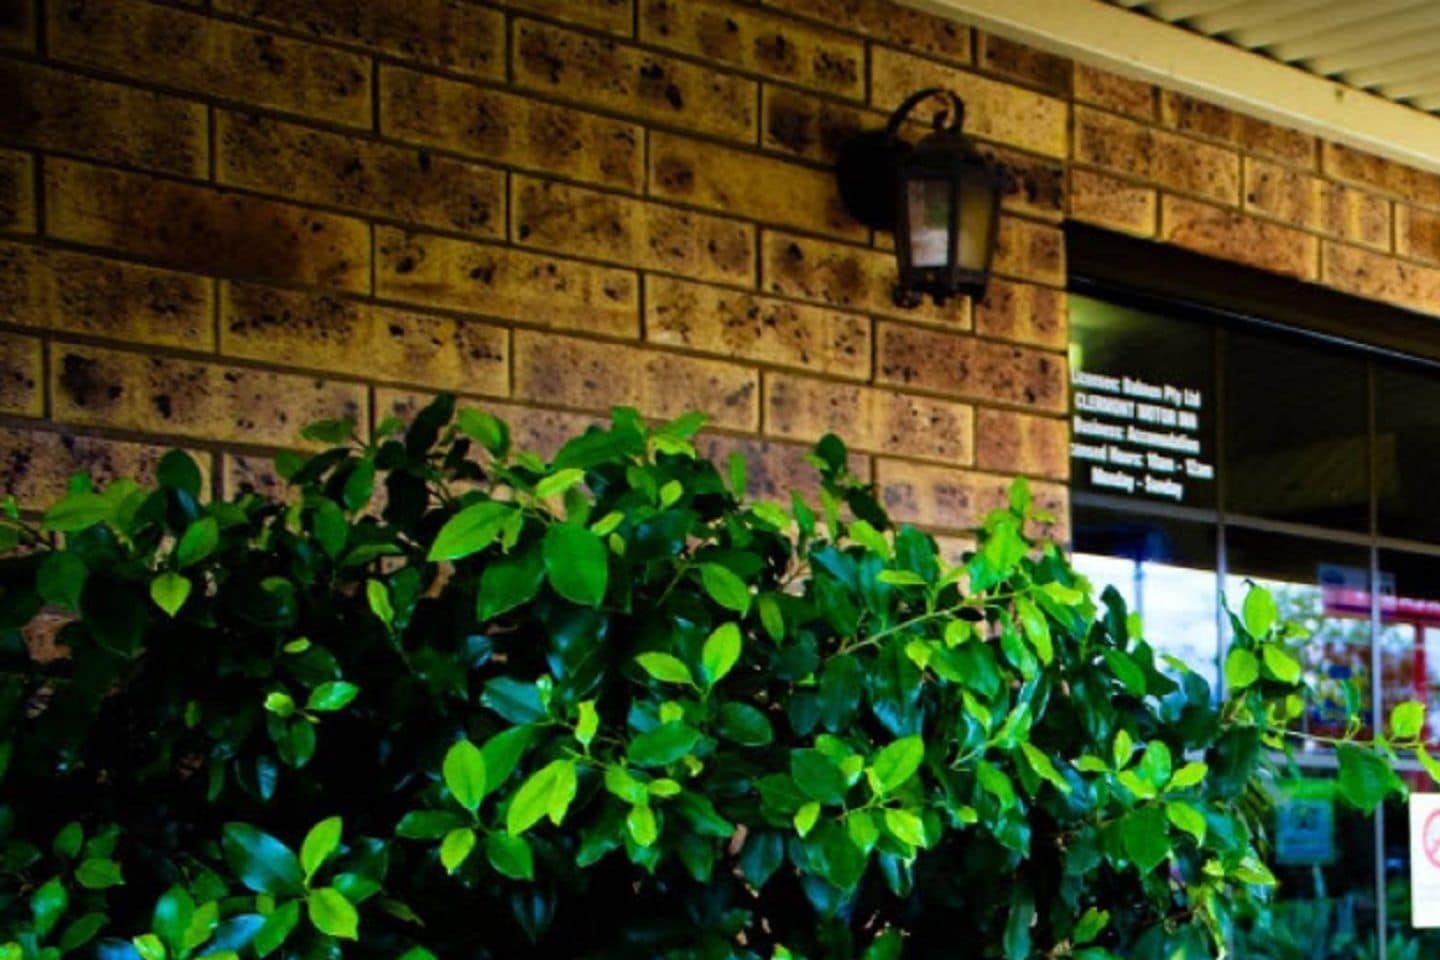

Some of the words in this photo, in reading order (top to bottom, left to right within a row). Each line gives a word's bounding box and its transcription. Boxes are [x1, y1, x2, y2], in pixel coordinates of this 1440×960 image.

[1074, 392, 1135, 418] CLERMONT
[1136, 403, 1177, 426] MOTOR
[1163, 384, 1182, 407] Pty
[1184, 388, 1201, 408] Ltd
[1091, 466, 1135, 493] Monday
[1145, 474, 1183, 500] Sunday
